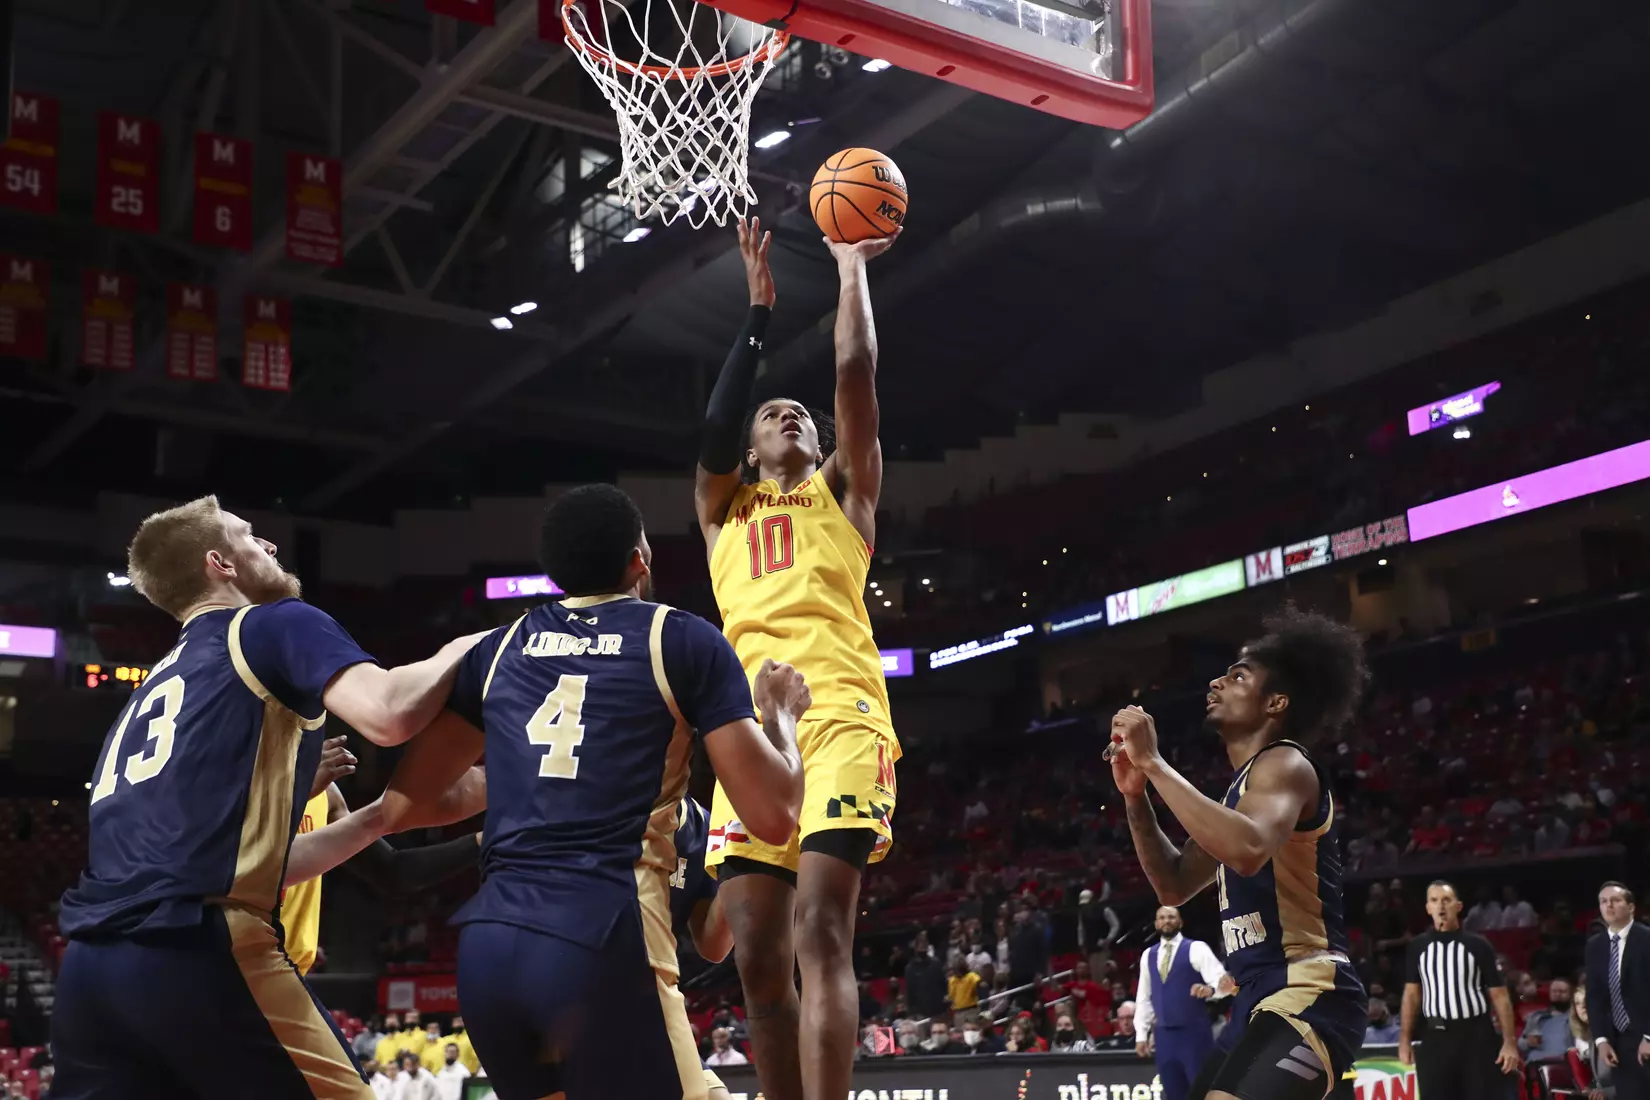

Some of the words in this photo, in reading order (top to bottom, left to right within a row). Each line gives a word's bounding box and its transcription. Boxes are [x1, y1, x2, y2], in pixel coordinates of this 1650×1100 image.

[14, 96, 38, 122] M
[117, 118, 141, 145] M
[212, 139, 235, 164] M
[5, 164, 42, 196] 54
[304, 159, 326, 183] M
[111, 185, 144, 216] 25
[215, 206, 231, 233] 6
[10, 259, 34, 282] M
[99, 275, 119, 297] M
[182, 286, 203, 309] M
[258, 299, 276, 319] M
[735, 494, 813, 528] MARYLAND
[747, 514, 794, 580] 10
[1254, 551, 1272, 580] M
[1115, 592, 1129, 619] M
[587, 633, 623, 655] JR
[90, 675, 185, 806] 13
[526, 674, 589, 780] 4
